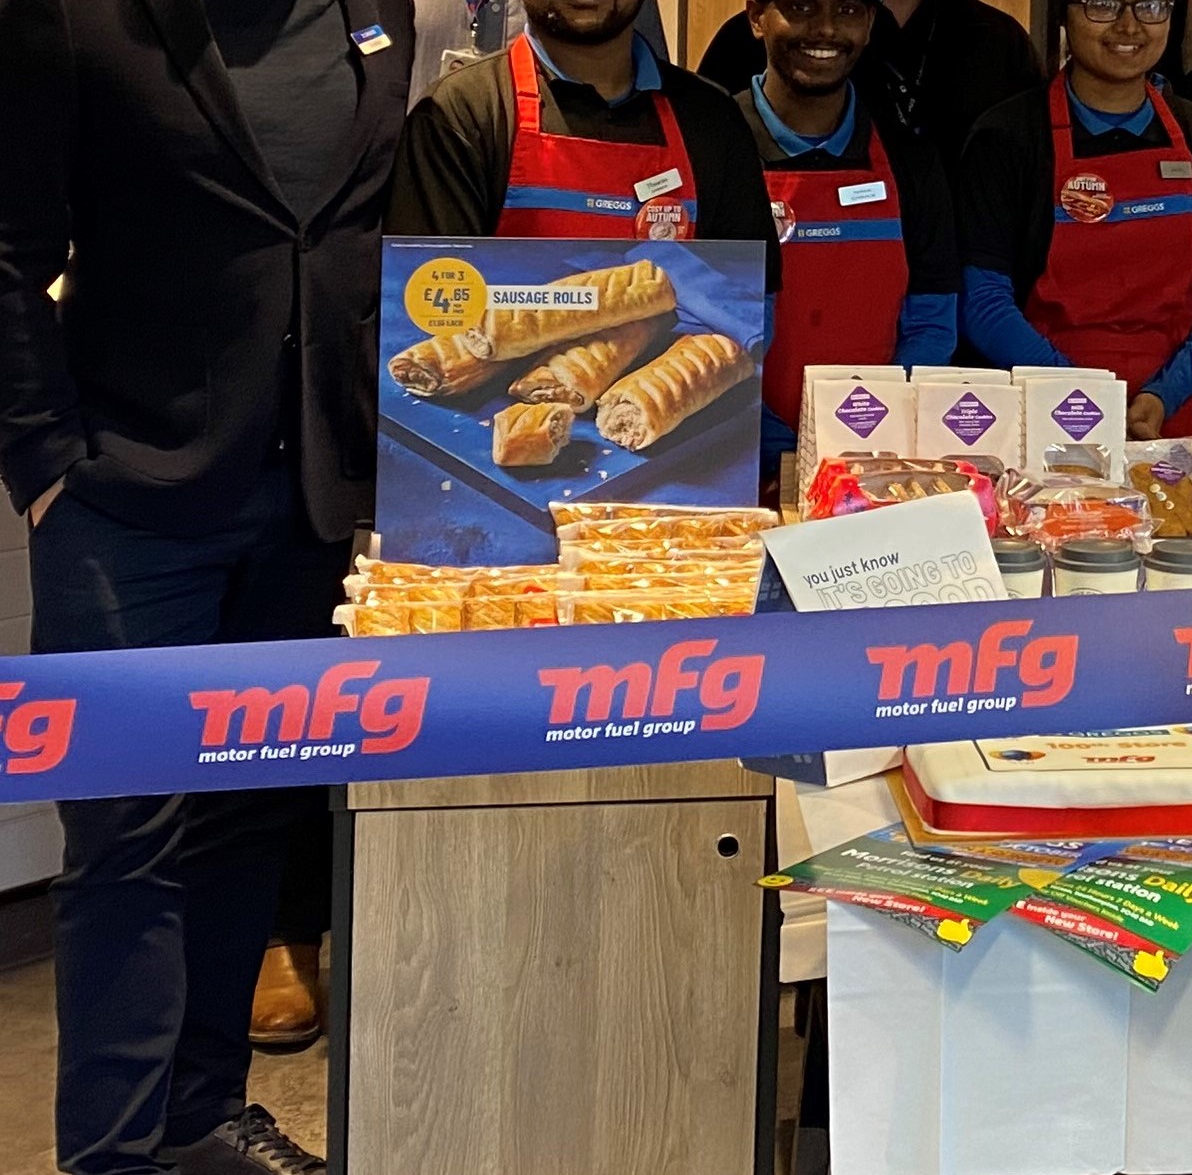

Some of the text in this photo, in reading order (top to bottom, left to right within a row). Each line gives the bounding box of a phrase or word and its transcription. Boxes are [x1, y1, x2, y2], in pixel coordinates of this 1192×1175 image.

[1068, 181, 1106, 192] AUTUMN
[595, 199, 632, 210] GREGGS
[1131, 203, 1165, 214] GREGGS
[646, 212, 681, 223] AUTUMN
[806, 227, 840, 237] GREGGS
[431, 271, 464, 281] 4 FOR 3
[493, 291, 593, 305] SAUSAGE ROLLS
[803, 552, 900, 588] you just know
[865, 560, 941, 598] GOING
[940, 550, 978, 580] TO
[865, 619, 1079, 709] mfg
[537, 639, 766, 732] mfg
[188, 660, 431, 754] mfg
[875, 696, 1017, 718] motor fuel group
[545, 720, 696, 742] motor fuel group
[198, 743, 355, 763] motor fuel group
[1117, 740, 1187, 749] Store
[840, 848, 958, 876] Morrisons
[856, 863, 975, 889] Petrol station
[1094, 877, 1162, 903] station
[852, 895, 926, 913] New Store!
[1026, 903, 1087, 921] inside your
[1044, 915, 1119, 941] New Store!
